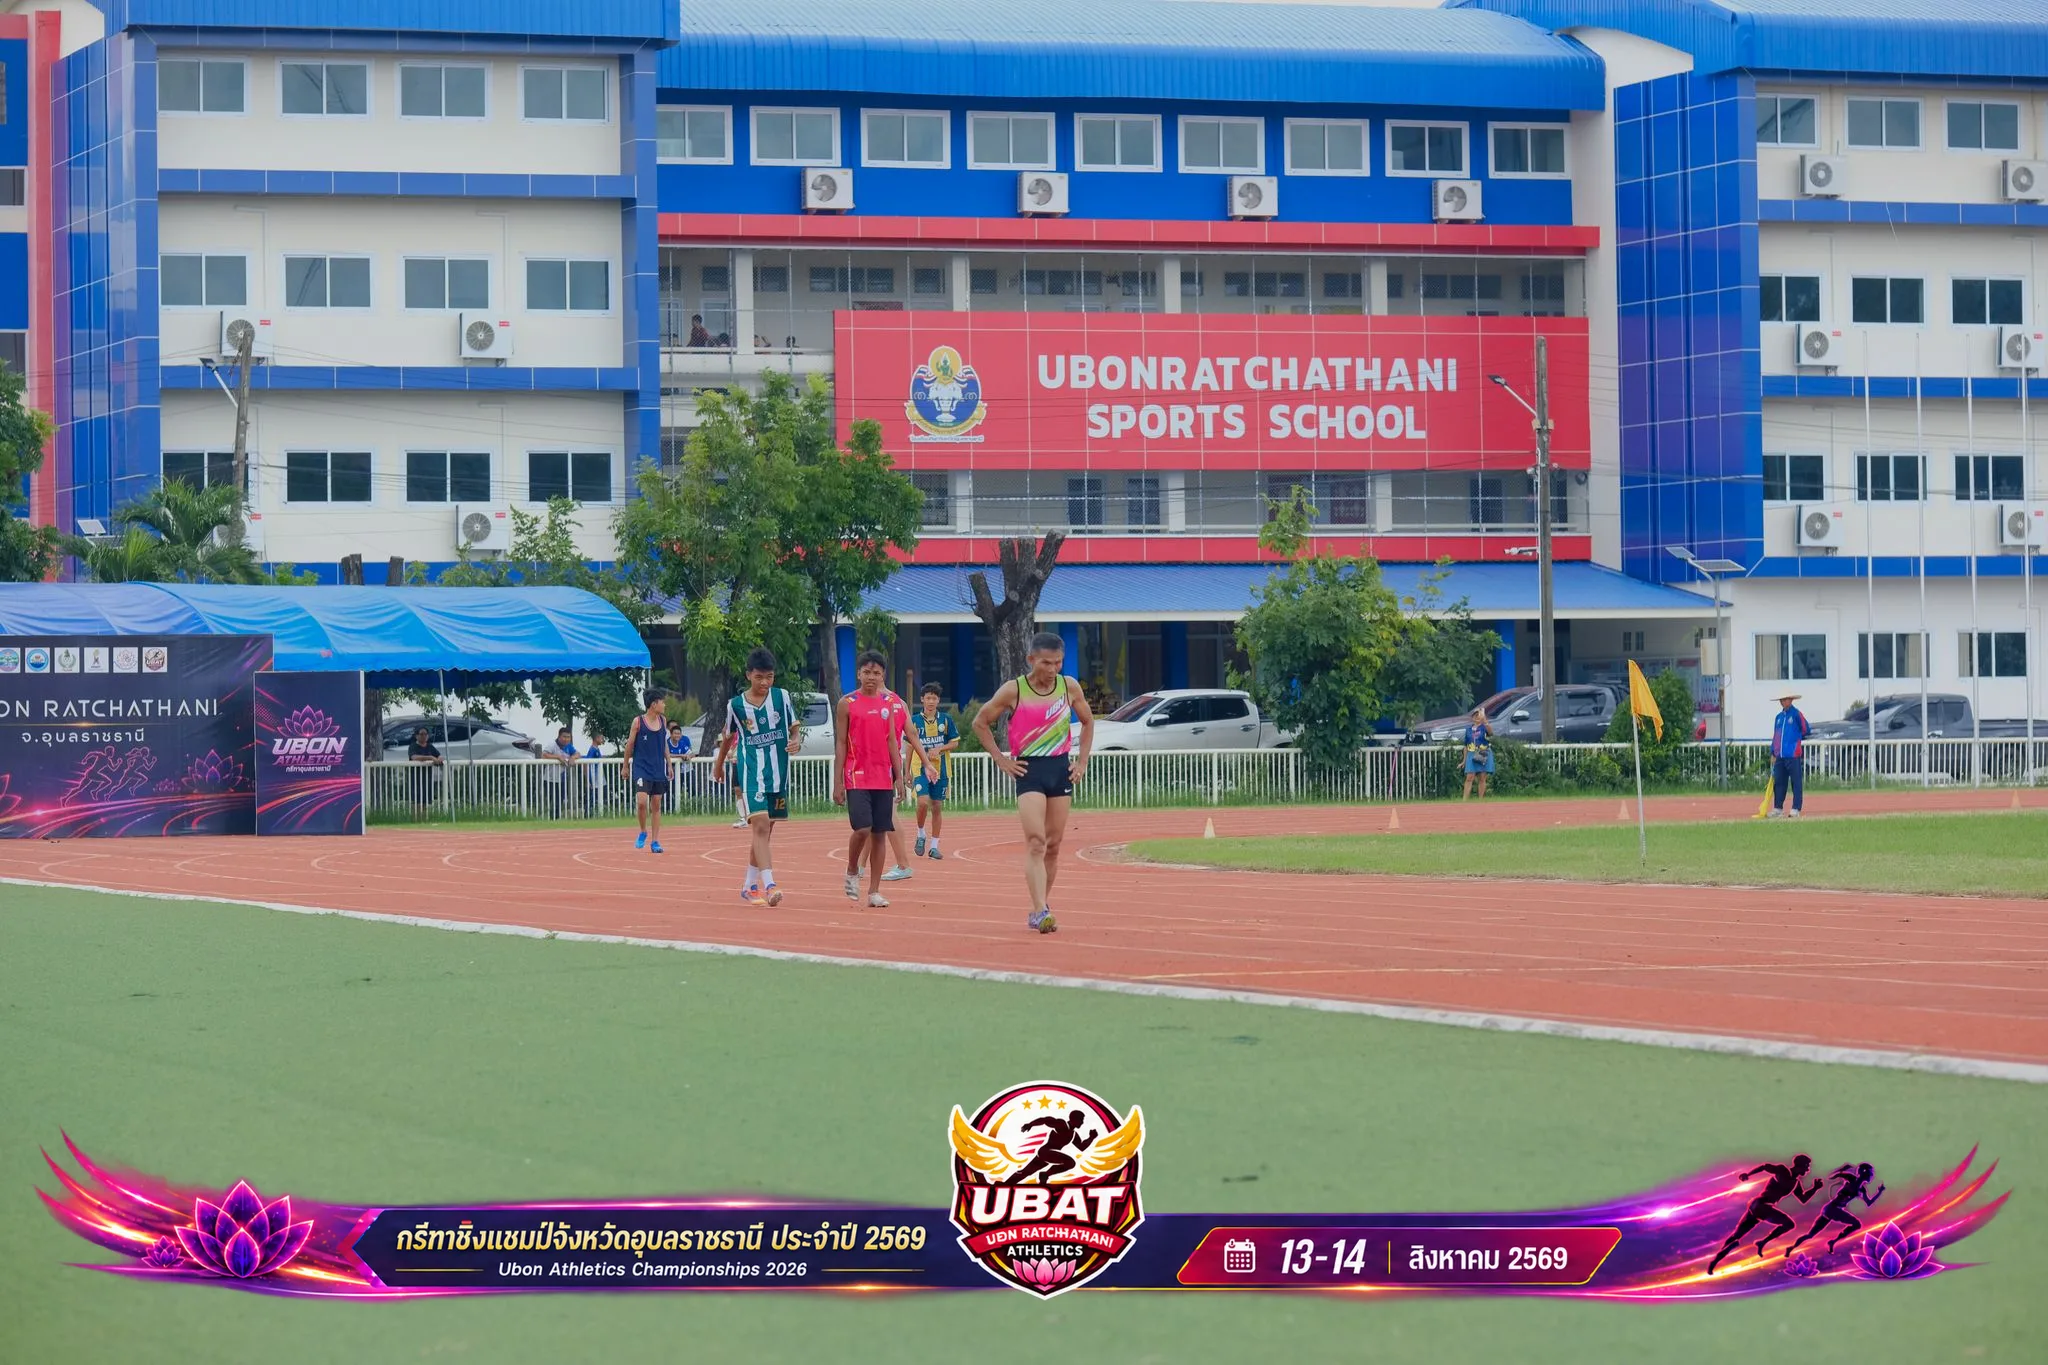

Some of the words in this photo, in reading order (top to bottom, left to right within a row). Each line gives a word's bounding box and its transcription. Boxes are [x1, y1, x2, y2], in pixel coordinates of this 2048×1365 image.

[1038, 355, 1458, 392] UBONRATCHATHANI
[1088, 404, 1246, 439] SPORTS
[1269, 404, 1426, 439] SCHOOL
[44, 698, 218, 718] RATCHATHANI
[272, 737, 348, 755] UBON
[274, 754, 345, 766] ATHLETICS
[774, 798, 786, 810] 12
